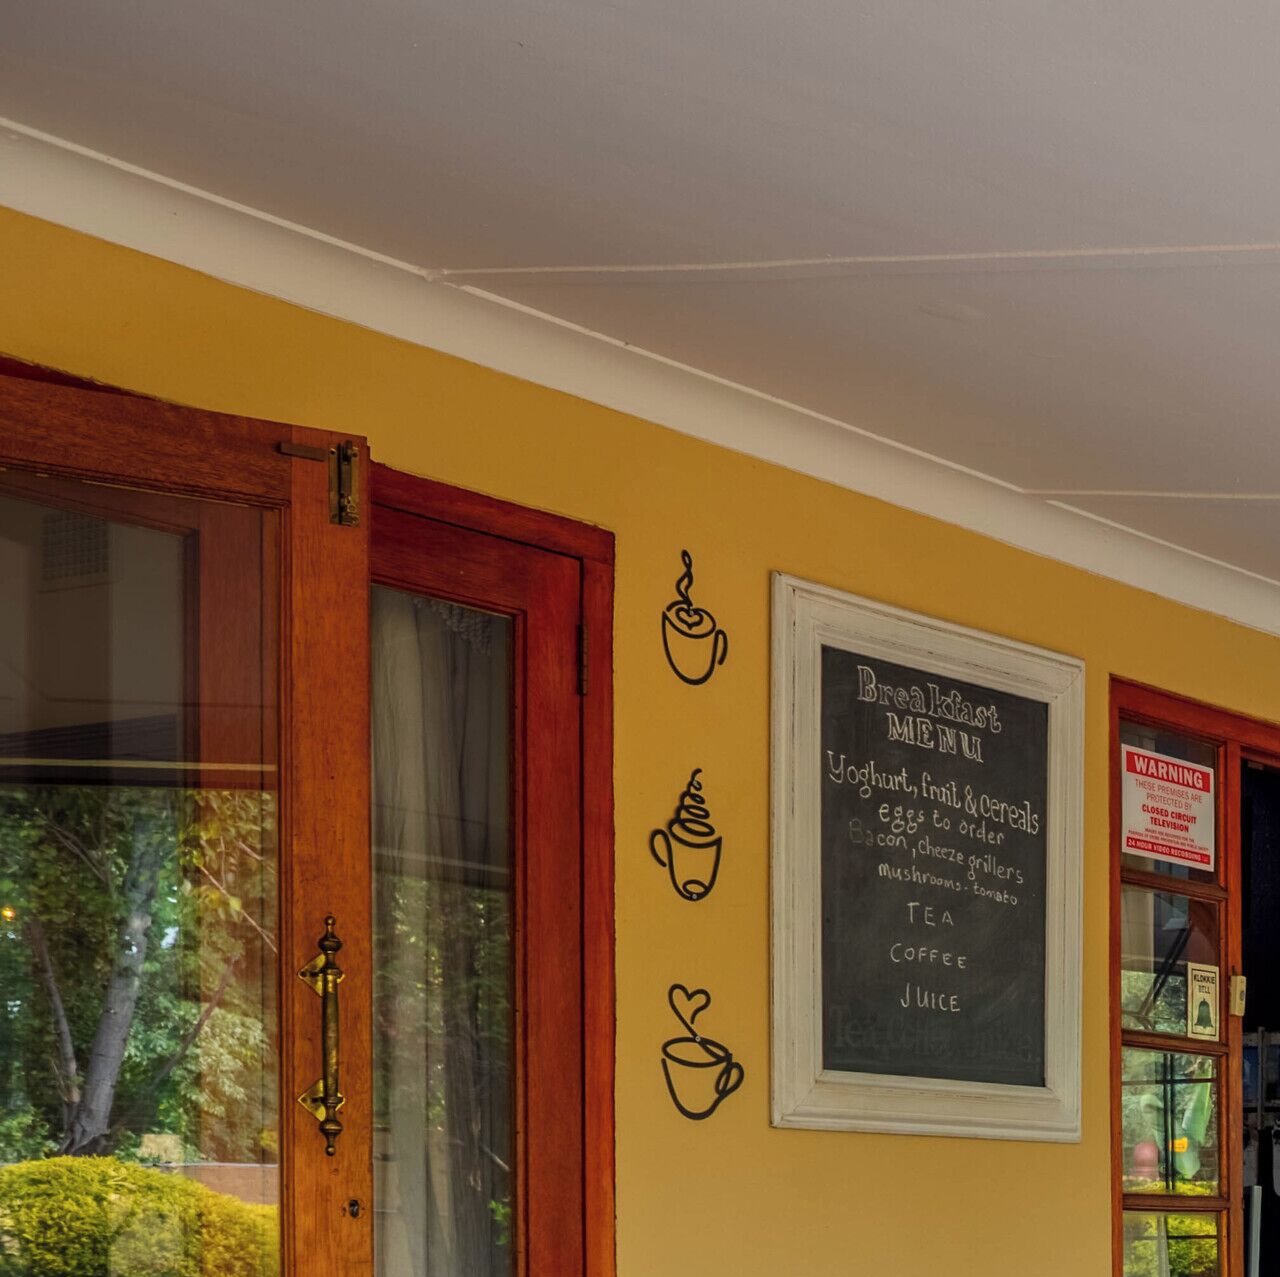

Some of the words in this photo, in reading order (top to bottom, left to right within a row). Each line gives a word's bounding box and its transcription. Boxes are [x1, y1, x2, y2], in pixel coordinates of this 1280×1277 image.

[857, 665, 1002, 733] Breakfast
[886, 713, 984, 763] MENU
[1134, 755, 1203, 788] WARNING
[827, 750, 919, 798] Yoghurt,
[922, 772, 962, 808] fruit
[965, 785, 978, 819] &
[980, 794, 1040, 835] cereals
[1135, 778, 1157, 792] THESE
[1158, 784, 1190, 801] PREMISES
[1190, 793, 1203, 804] ARE
[1146, 792, 1183, 809] PROTECTED
[1184, 801, 1193, 811] BY
[878, 803, 925, 833] eggs
[933, 809, 951, 831] to
[959, 819, 1005, 845] order
[1142, 804, 1169, 817] CLOSED
[1170, 810, 1197, 824] CIRCUIT
[1150, 816, 1189, 833] TELEVISION
[1128, 838, 1136, 847] 24
[1136, 840, 1152, 851] HOUR
[1153, 844, 1170, 856] VIDEO
[968, 854, 1024, 884] grillers
[973, 883, 1018, 905] tomato
[907, 902, 954, 926] TEA
[890, 943, 967, 969] COFFEE
[900, 983, 961, 1012] JUICE
